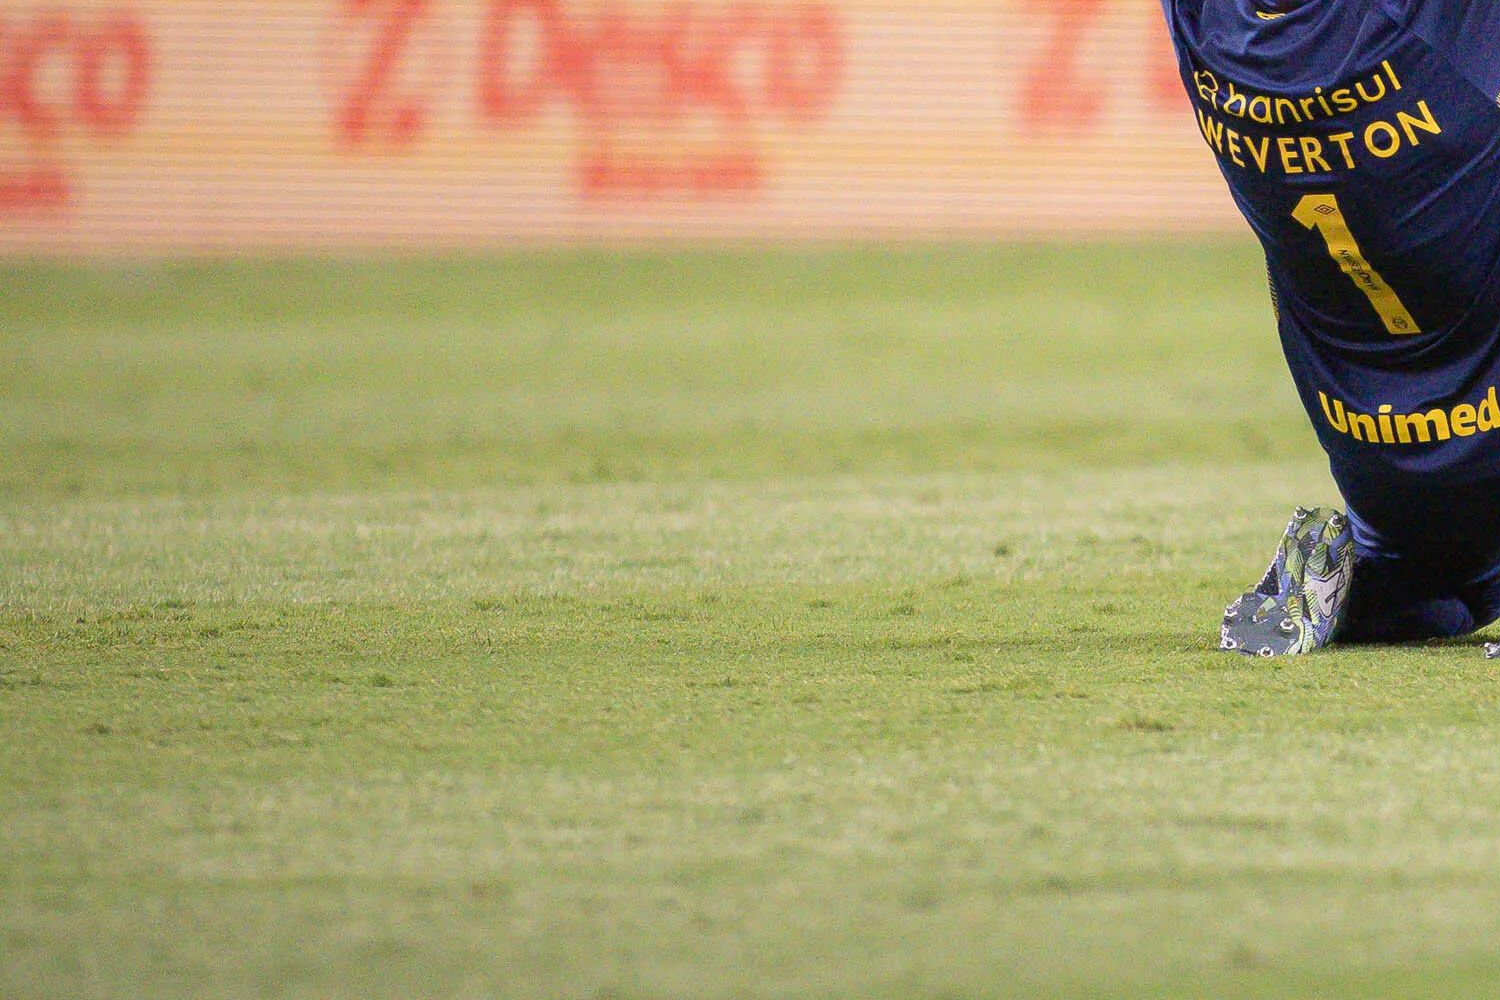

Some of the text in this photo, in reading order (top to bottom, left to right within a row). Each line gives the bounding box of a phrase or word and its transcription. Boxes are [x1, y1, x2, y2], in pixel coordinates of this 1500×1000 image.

[1223, 60, 1402, 124] banrisul
[1198, 100, 1442, 174] WEVERTON
[1291, 194, 1421, 335] 1
